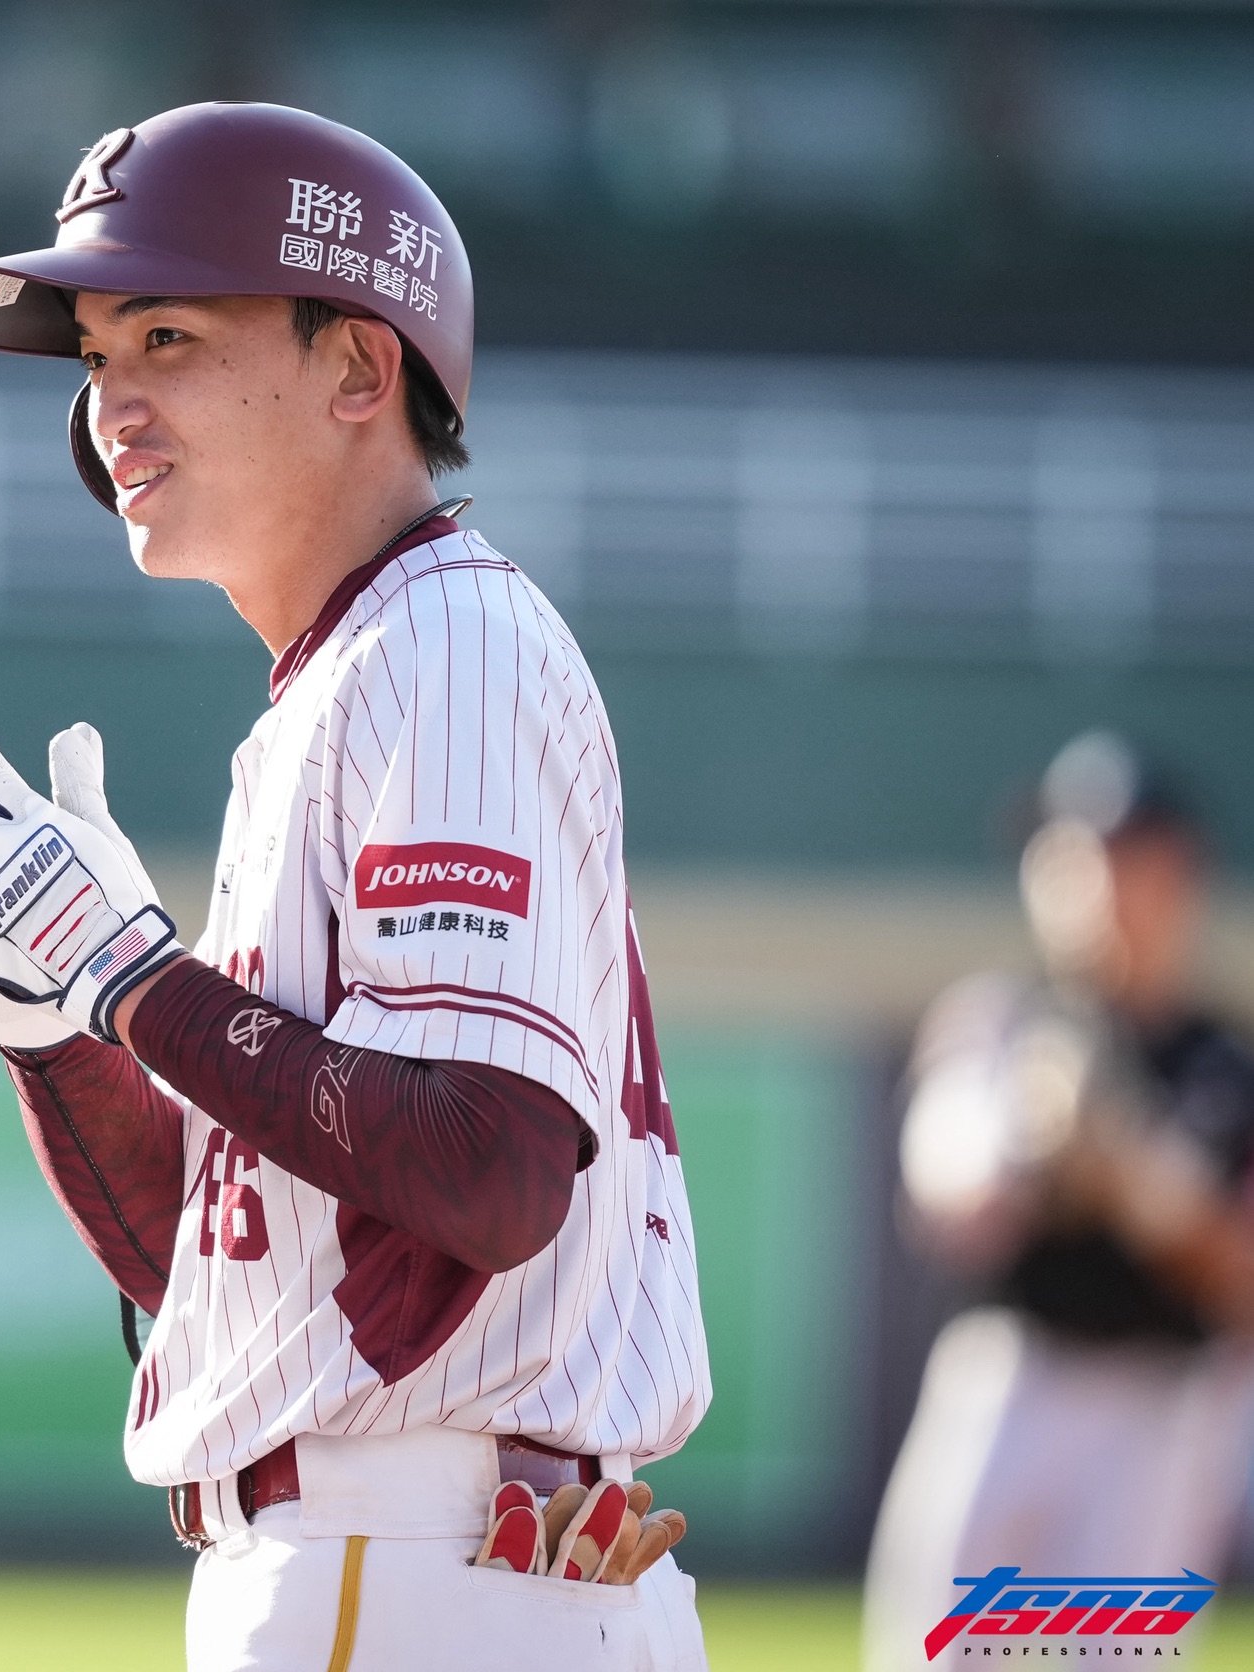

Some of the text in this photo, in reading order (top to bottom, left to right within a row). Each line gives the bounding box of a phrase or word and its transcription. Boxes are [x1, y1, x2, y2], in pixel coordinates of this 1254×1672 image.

[287, 177, 443, 282] 聯新
[279, 233, 438, 322] 國際醫院
[365, 861, 515, 892] JOHNSON
[377, 911, 510, 941] 喬山健康科技
